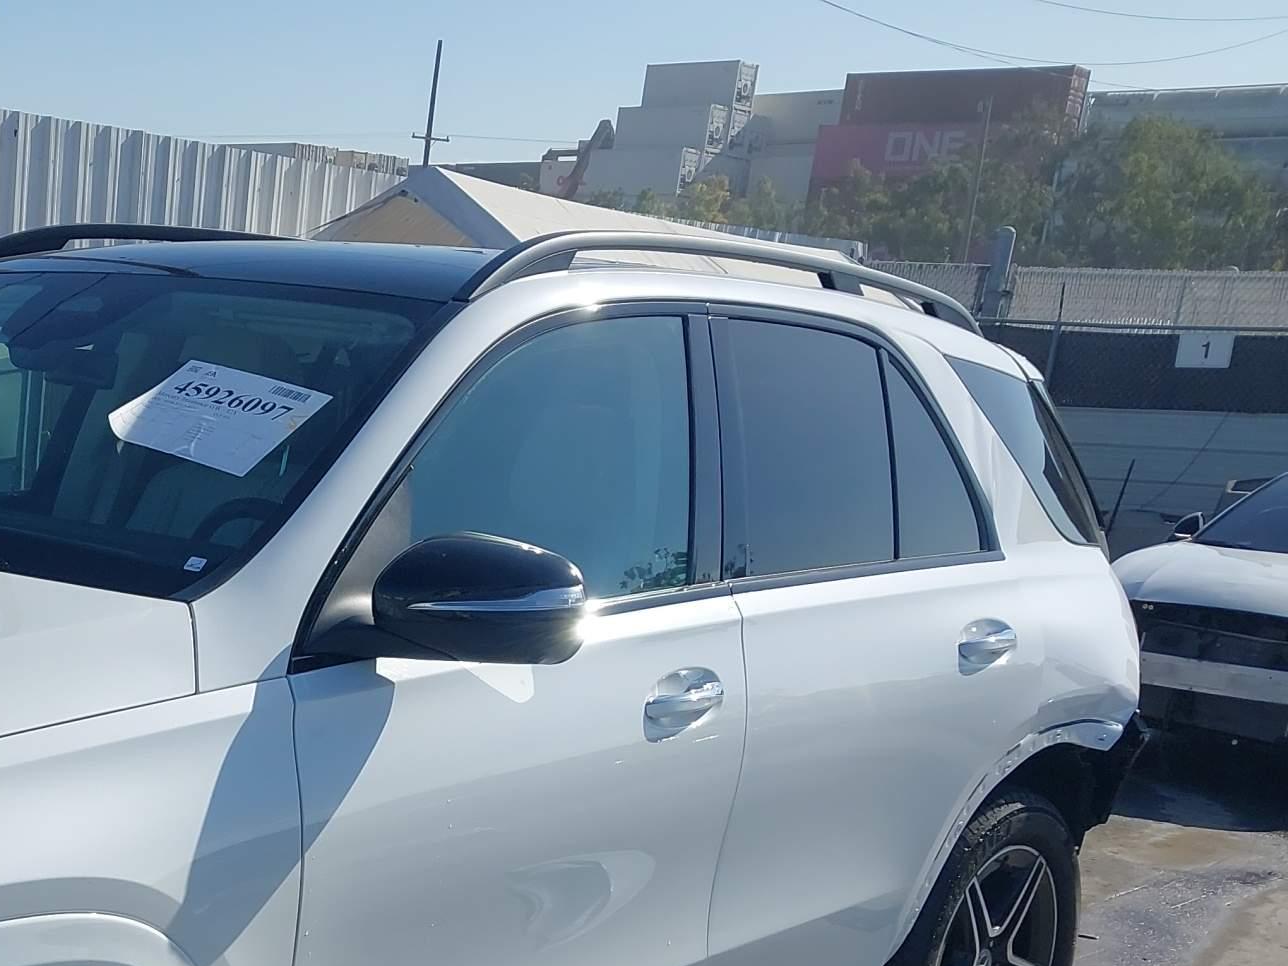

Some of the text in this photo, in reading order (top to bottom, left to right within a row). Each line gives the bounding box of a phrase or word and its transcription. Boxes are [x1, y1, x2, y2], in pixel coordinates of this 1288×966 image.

[884, 131, 965, 161] ONE
[1202, 341, 1211, 359] 1
[173, 380, 294, 420] 45926097
